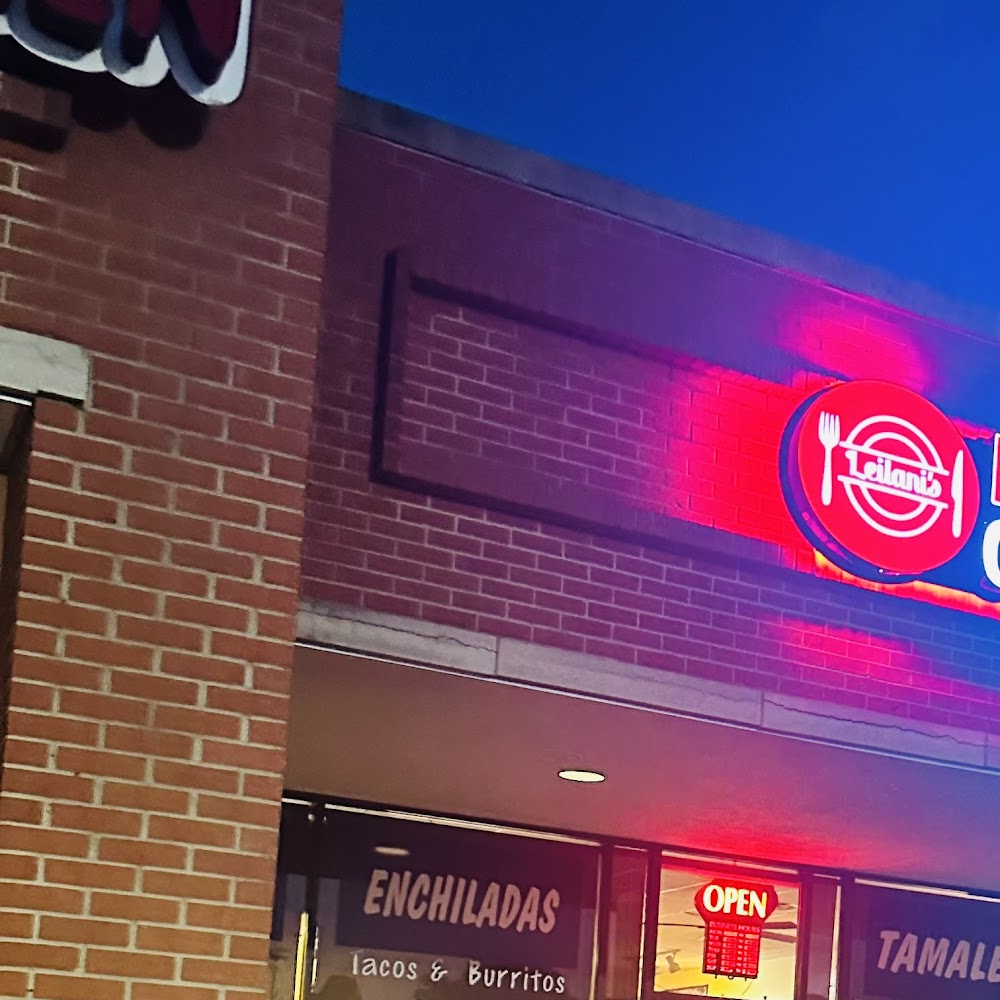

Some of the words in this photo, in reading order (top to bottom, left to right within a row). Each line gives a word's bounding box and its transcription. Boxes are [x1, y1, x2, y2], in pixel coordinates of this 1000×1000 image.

[844, 450, 942, 498] Leilani's
[364, 868, 560, 934] ENCHILADAS
[702, 884, 768, 919] OPEN
[350, 949, 417, 981] Tacos
[430, 957, 448, 982] &
[468, 959, 566, 994] Burritos
